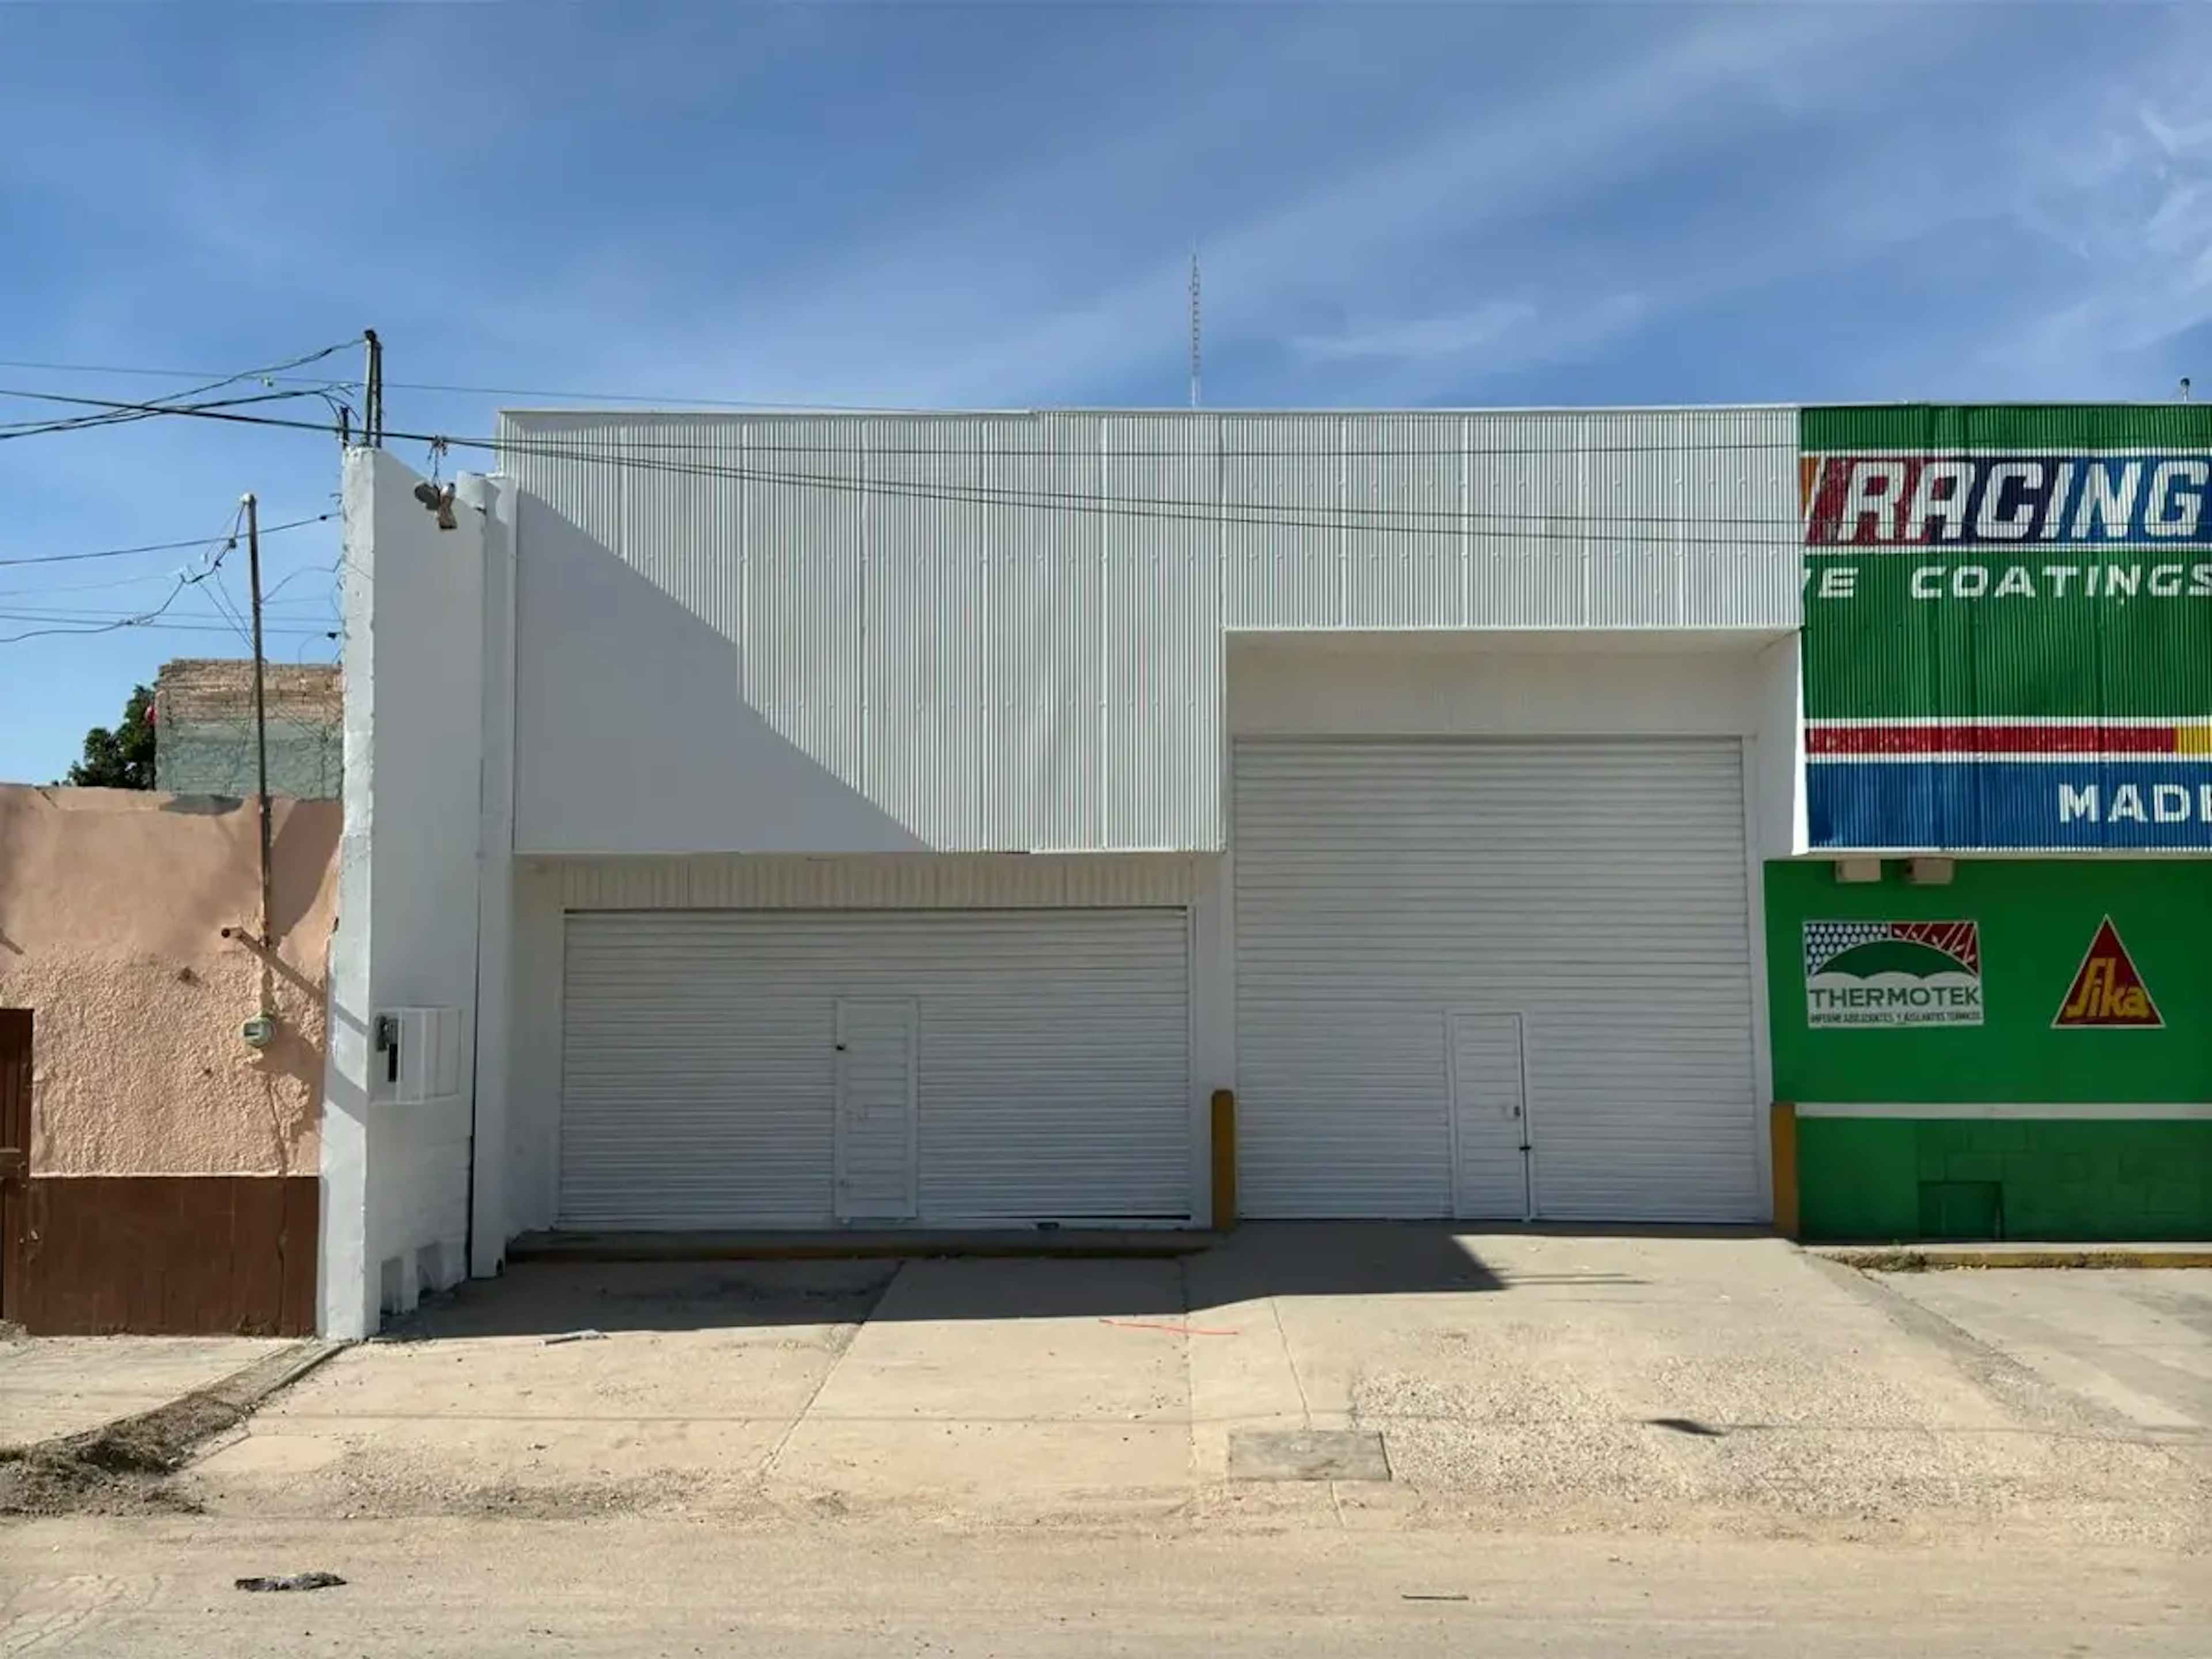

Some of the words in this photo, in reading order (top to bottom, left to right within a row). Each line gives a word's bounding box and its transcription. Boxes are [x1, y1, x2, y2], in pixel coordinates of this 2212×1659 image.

[1838, 460, 2210, 540] RACING
[1911, 564, 2212, 599] COATINGS
[1809, 987, 1979, 1008] THERMOTEK
[2065, 957, 2150, 1018] Sika
